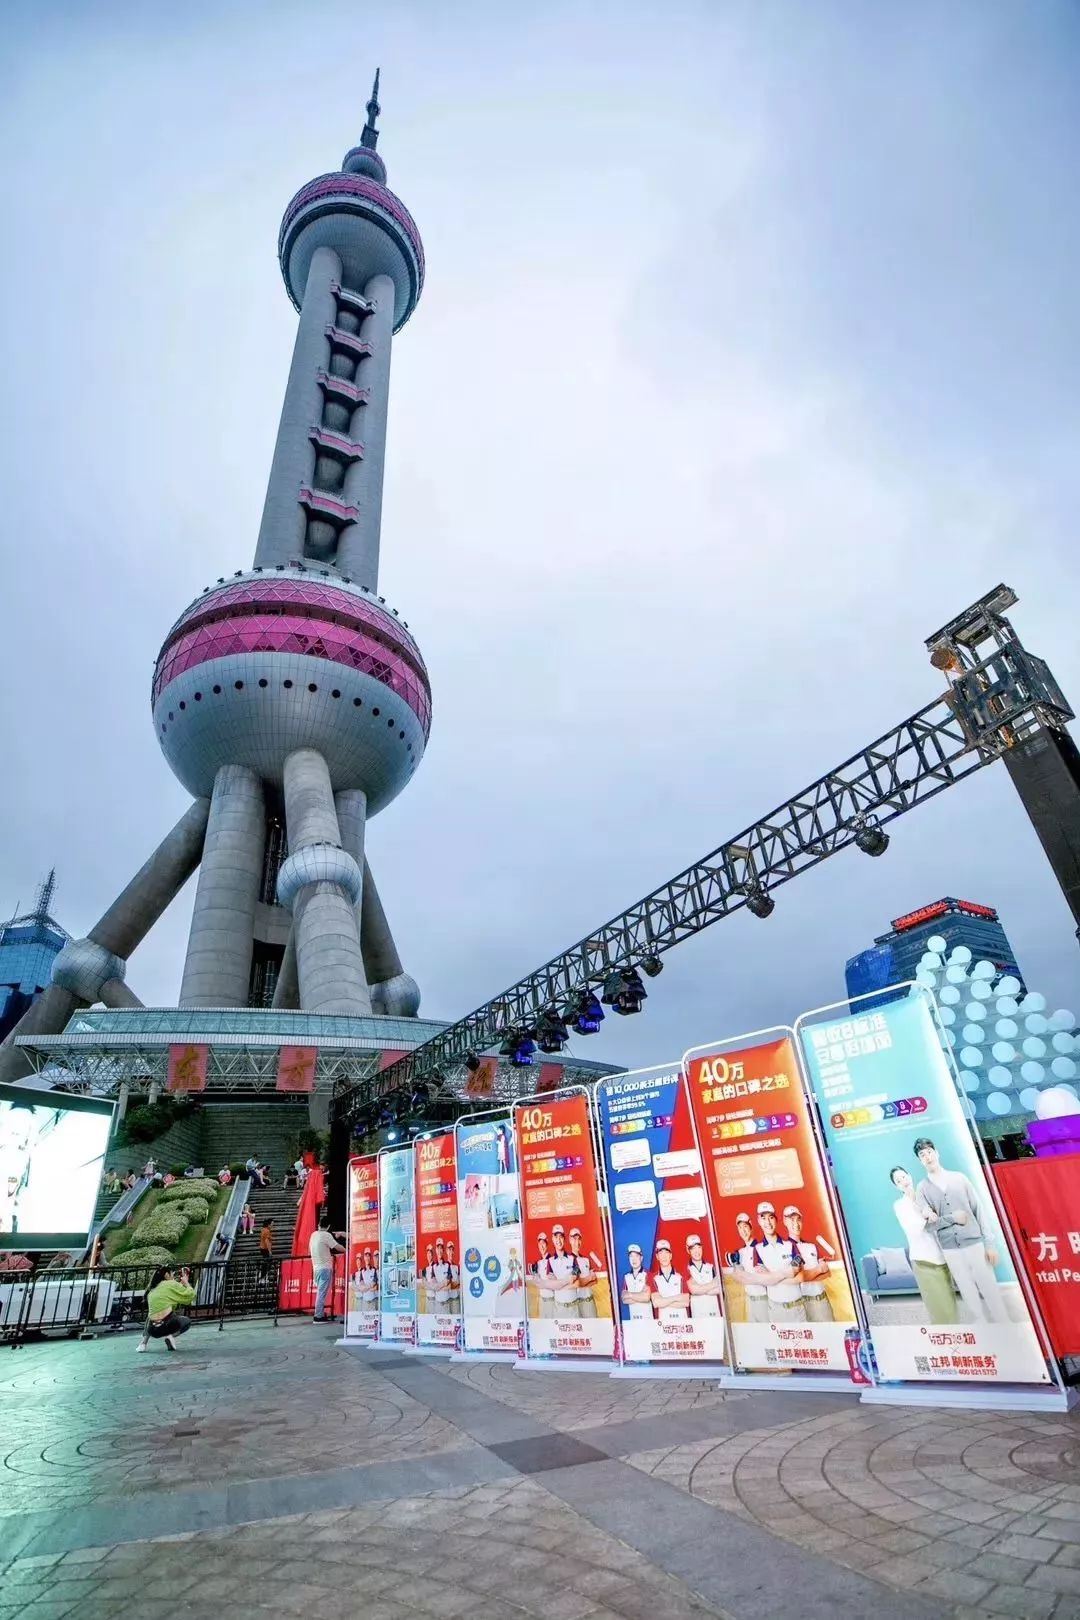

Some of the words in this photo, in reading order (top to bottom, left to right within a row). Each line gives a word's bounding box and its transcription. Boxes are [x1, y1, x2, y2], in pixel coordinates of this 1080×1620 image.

[699, 1058, 744, 1086] 40万
[702, 1073, 790, 1104] 家庭的口碑之选
[521, 1108, 552, 1130] 40万
[420, 1142, 440, 1160] 40万
[661, 1342, 675, 1350] 立邦
[676, 1341, 704, 1350] 刷新服务
[777, 1348, 792, 1358] 立邦
[794, 1348, 827, 1358] 刷新服务
[929, 1355, 950, 1367] 立邦
[952, 1355, 995, 1367] 刷新服务
